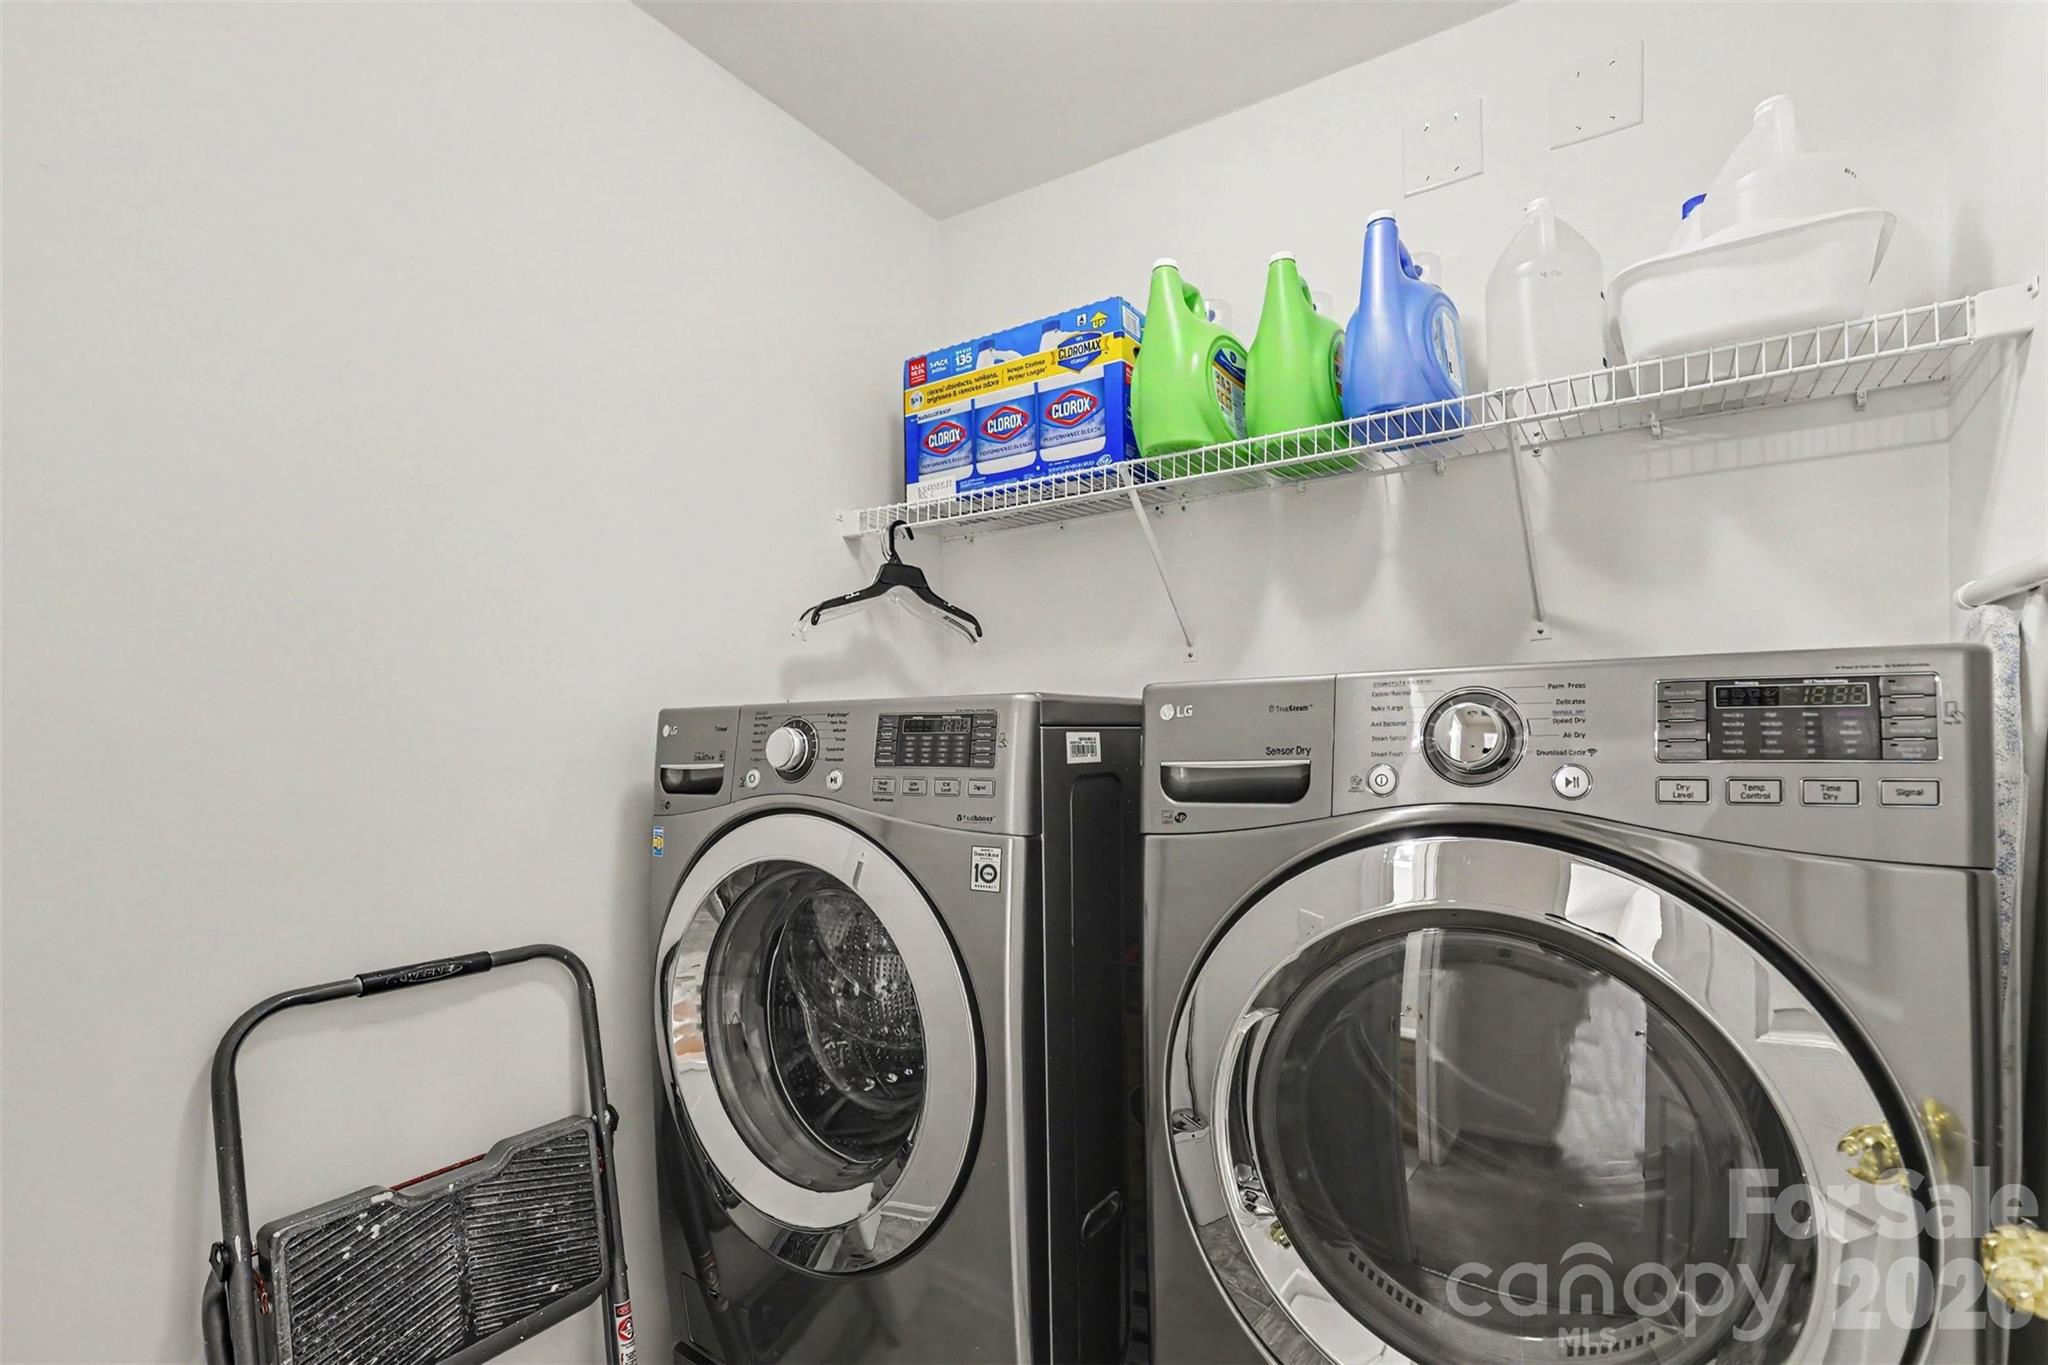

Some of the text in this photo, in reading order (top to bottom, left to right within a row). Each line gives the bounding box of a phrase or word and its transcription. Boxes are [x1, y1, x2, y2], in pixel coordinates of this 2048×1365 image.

[1092, 319, 1106, 329] UP
[1058, 339, 1101, 361] CLOROMAX
[1051, 396, 1091, 419] CLOROX
[987, 413, 1023, 434] CLOROX
[928, 428, 961, 448] CLOROX
[1176, 704, 1193, 717] LG
[1574, 731, 1586, 739] Dry
[1266, 746, 1311, 757] Sensor Dry
[1676, 783, 1690, 791] Dry
[1673, 791, 1694, 799] Level
[1740, 791, 1771, 800] Control
[1823, 793, 1838, 801] Dry
[1895, 788, 1924, 797] Signal
[974, 863, 998, 884] 10
